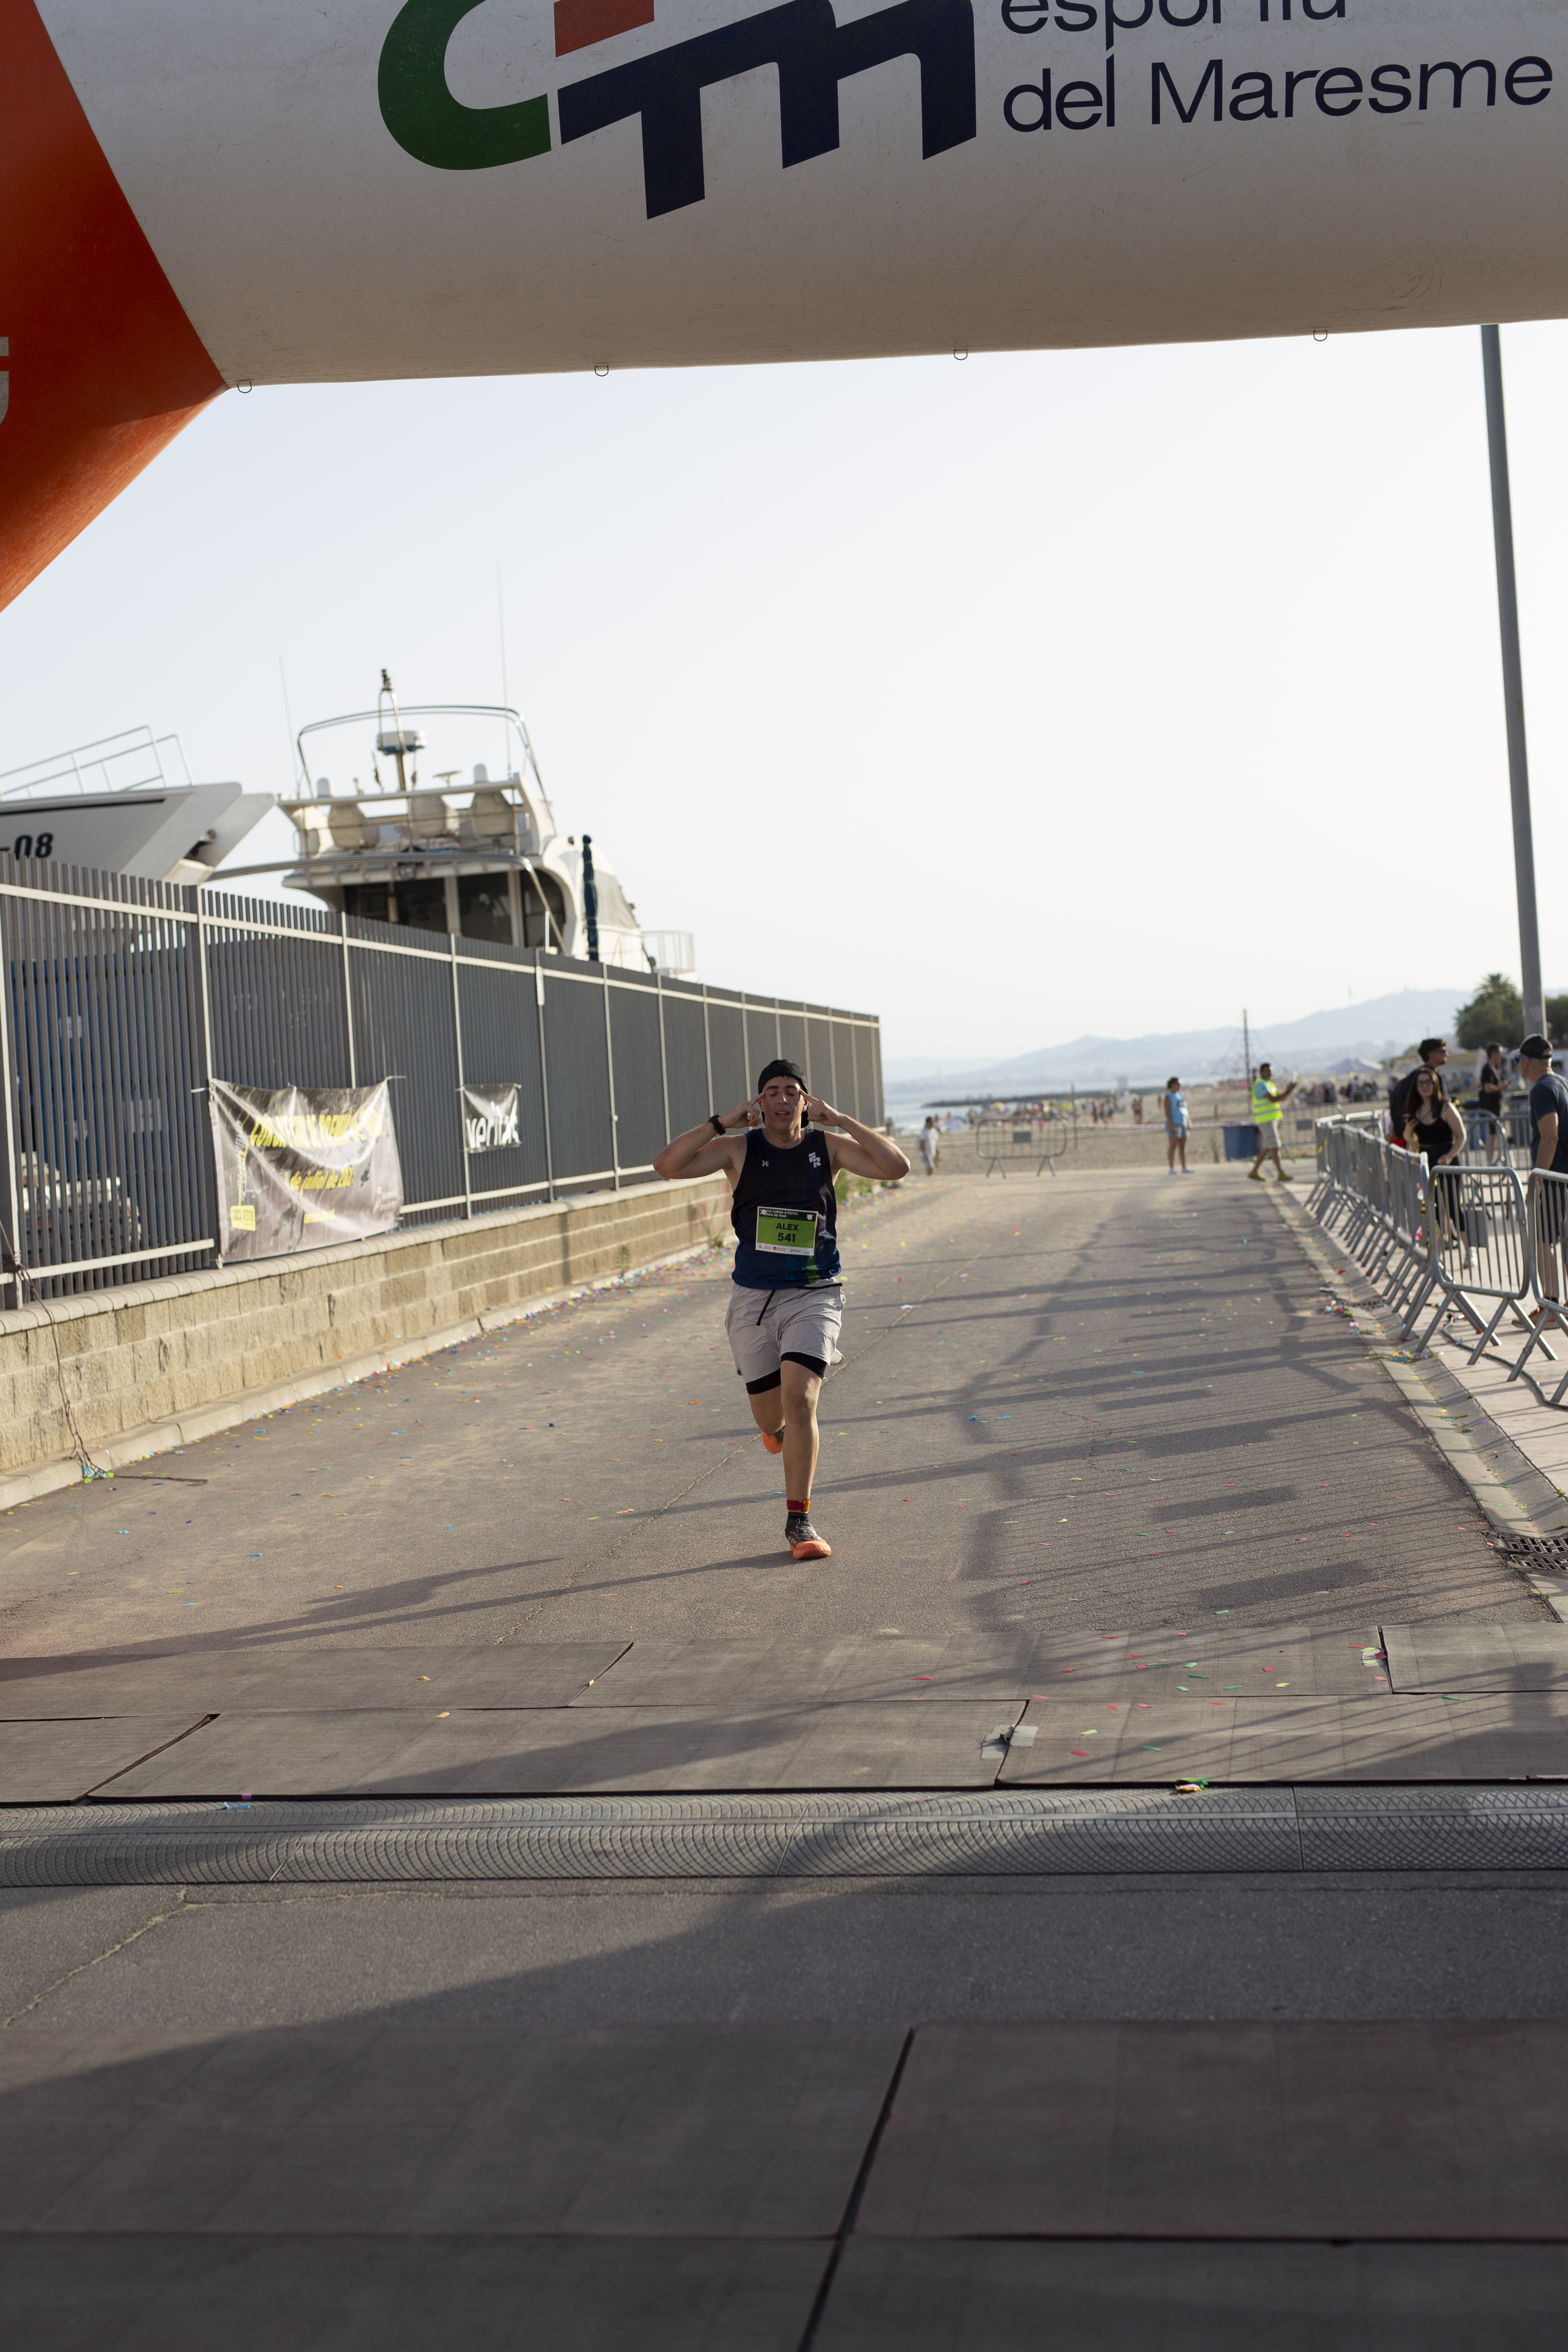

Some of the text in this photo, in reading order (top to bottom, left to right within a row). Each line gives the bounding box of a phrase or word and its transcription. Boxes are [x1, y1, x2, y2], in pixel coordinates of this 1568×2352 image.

[1003, 53, 1553, 133] del Maresme
[775, 1222, 799, 1231] ALEX
[777, 1232, 796, 1243] 541
